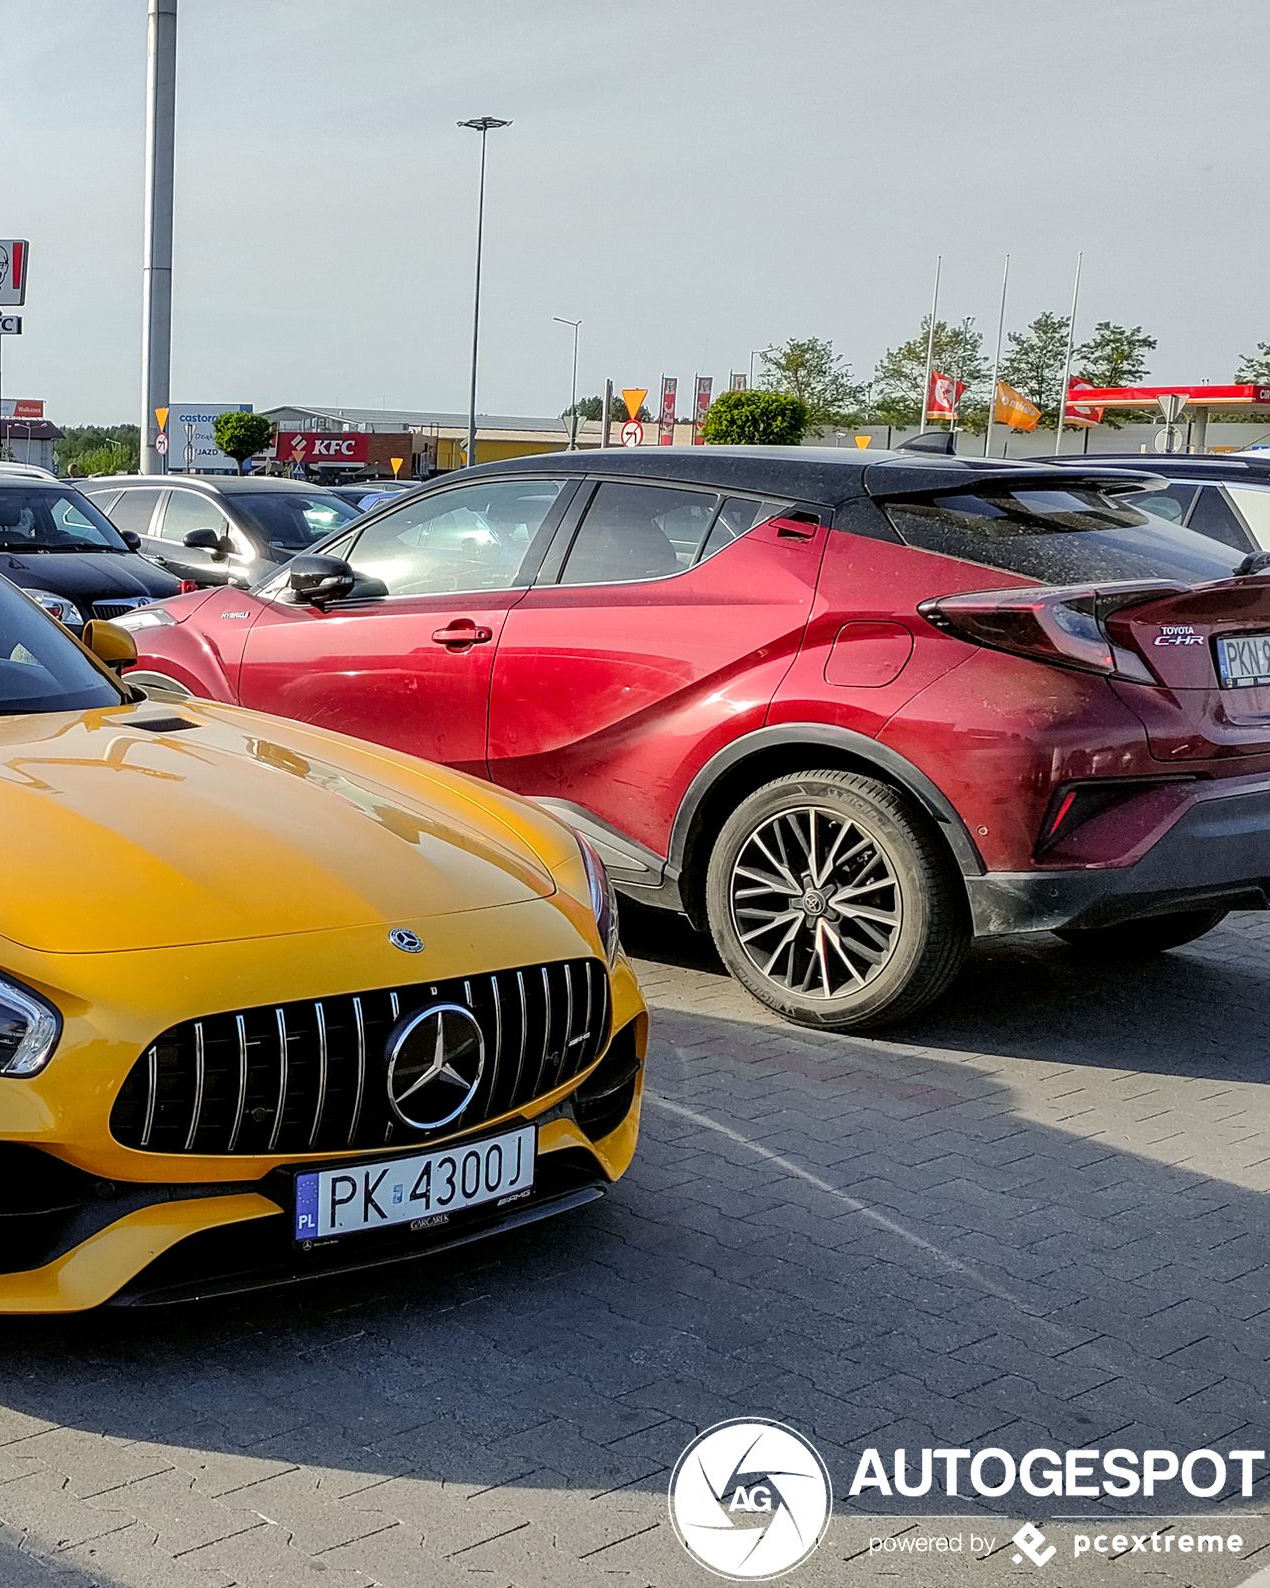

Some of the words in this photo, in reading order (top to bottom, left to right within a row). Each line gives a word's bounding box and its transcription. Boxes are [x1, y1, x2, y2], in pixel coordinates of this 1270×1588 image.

[661, 401, 675, 436] KFC
[312, 439, 357, 456] KFC
[1161, 626, 1195, 635] TOYOTA
[1154, 635, 1205, 646] C-HR
[1226, 640, 1262, 677] PKN
[330, 1168, 390, 1229] PK
[409, 1136, 523, 1211] 4300J
[298, 1215, 315, 1230] PL
